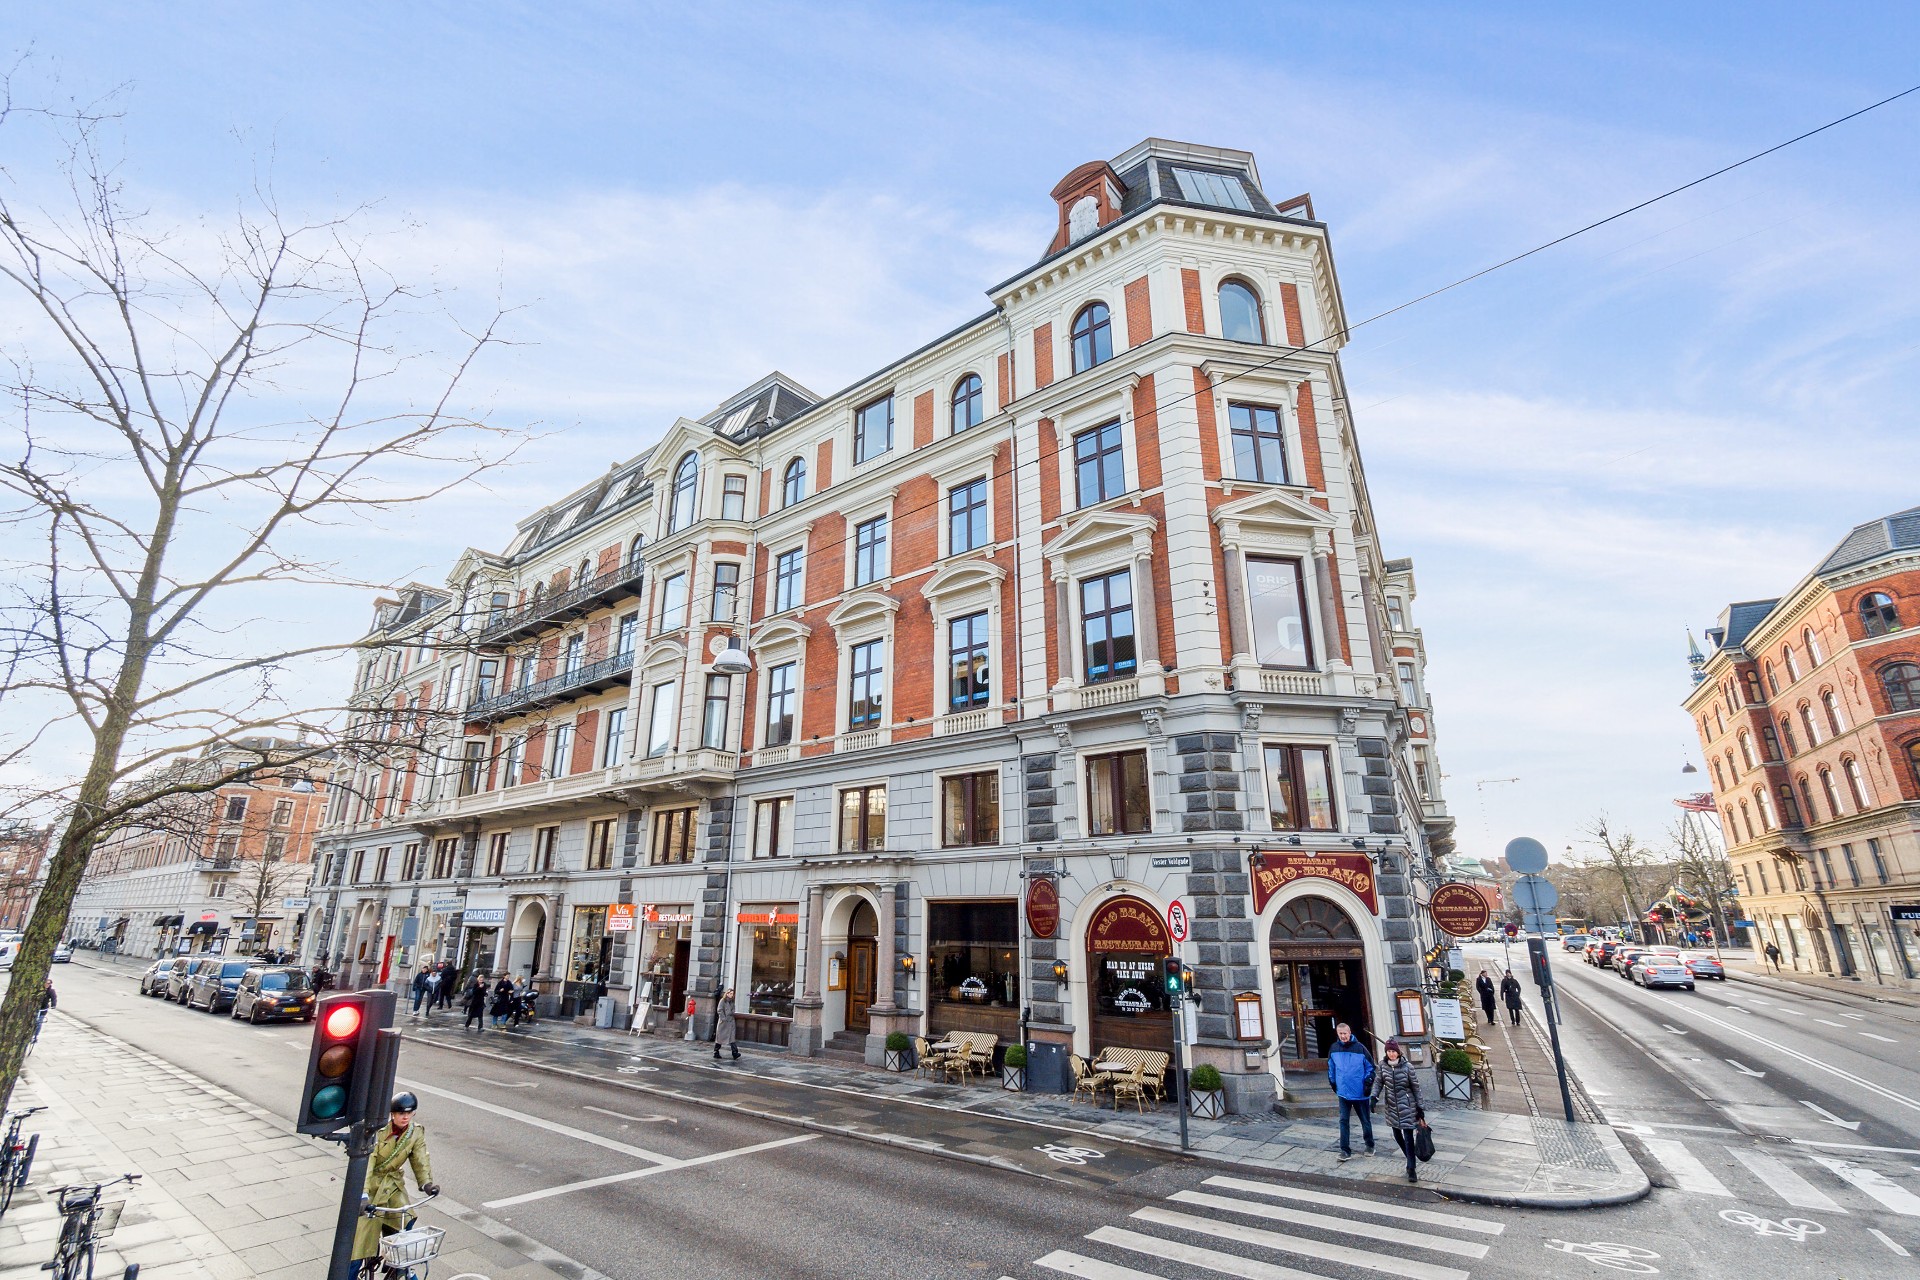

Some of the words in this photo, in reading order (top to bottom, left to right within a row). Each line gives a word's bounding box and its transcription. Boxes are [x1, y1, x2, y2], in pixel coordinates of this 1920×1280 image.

[1256, 574, 1289, 585] ORIS
[1287, 857, 1337, 866] RESTAURANT
[1437, 891, 1451, 904] RIO
[1451, 889, 1480, 905] BRAVO
[464, 909, 506, 920] CHARCUTERI
[658, 914, 692, 922] RESTAURANT
[1097, 911, 1118, 936] RIO
[1118, 907, 1159, 936] BRAVO
[1094, 939, 1165, 951] RESTAURANT
[1106, 960, 1118, 969] MAD
[1116, 970, 1130, 979] TAKE
[1131, 970, 1145, 980] AWAY
[1114, 1000, 1152, 1008] RESTAURANT
